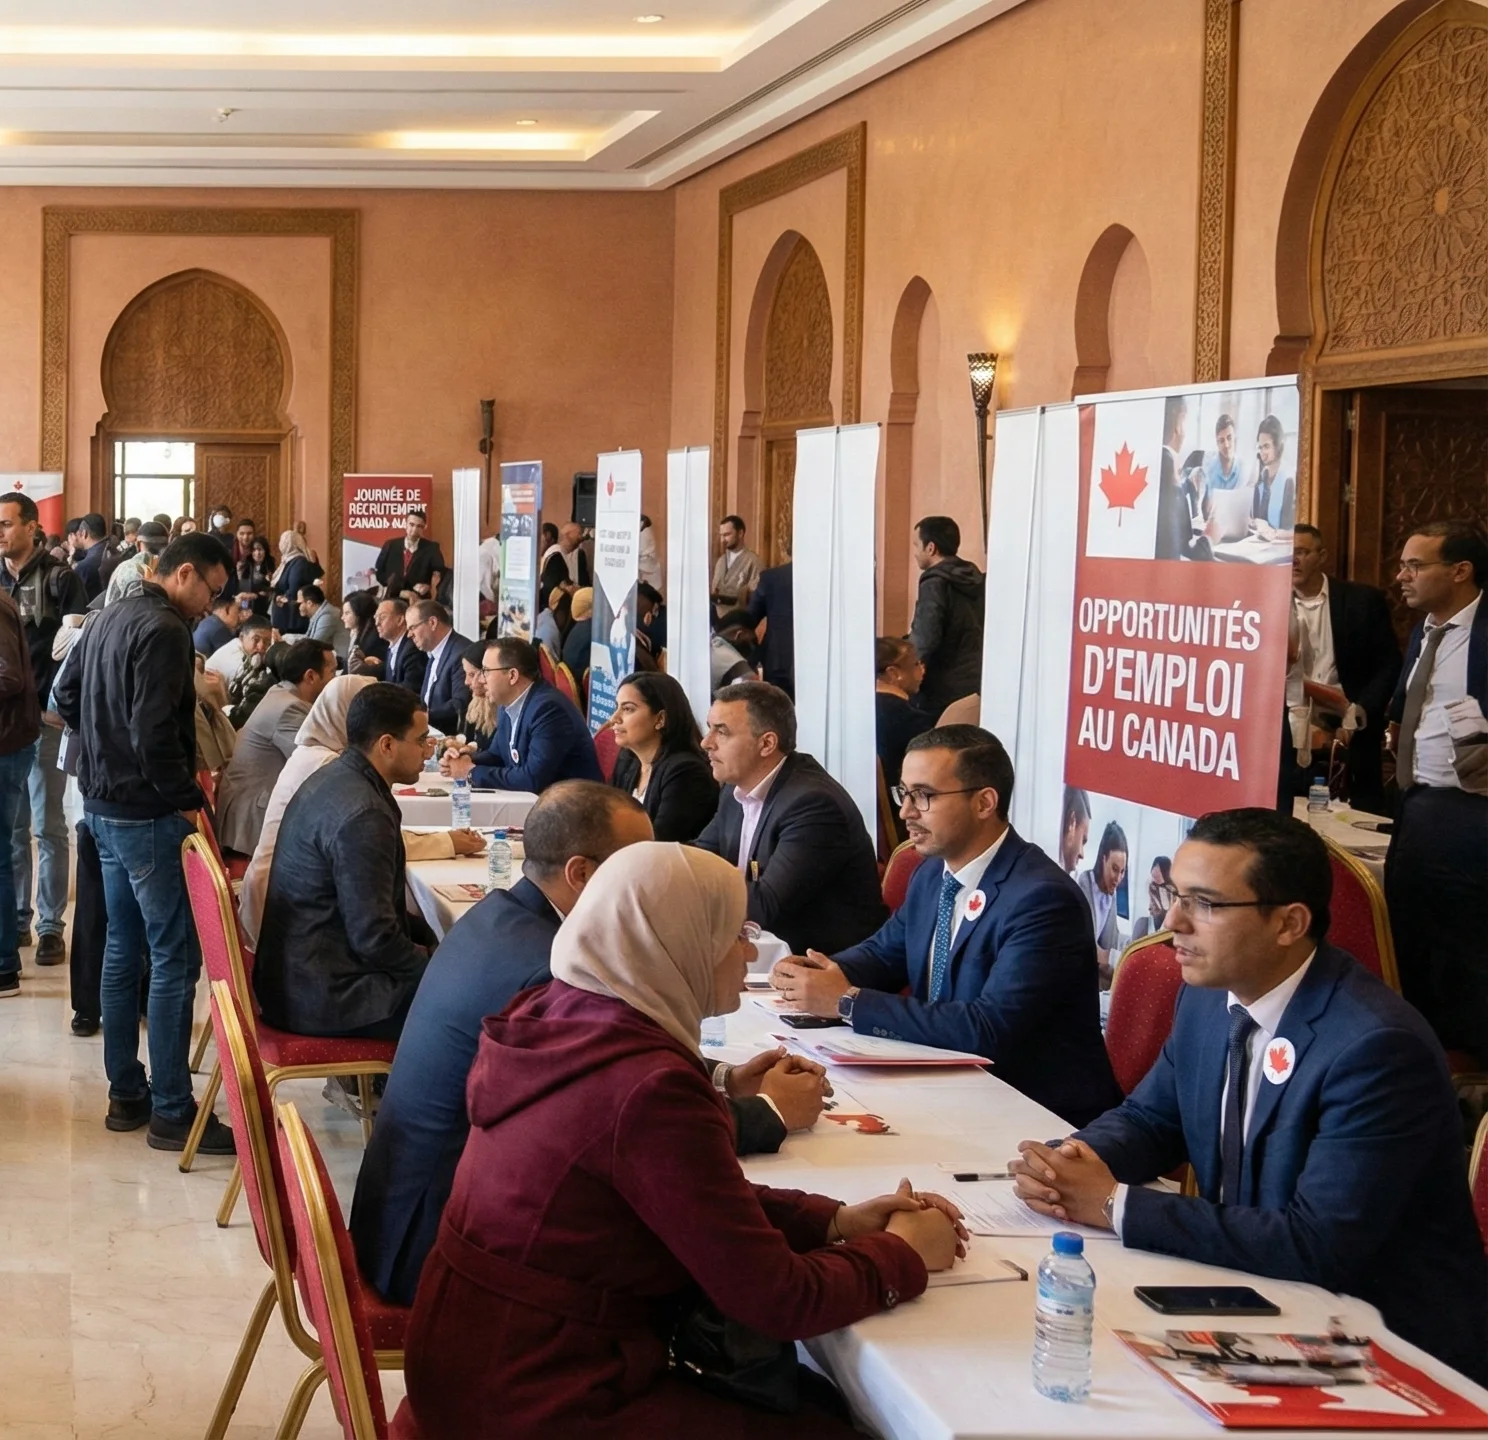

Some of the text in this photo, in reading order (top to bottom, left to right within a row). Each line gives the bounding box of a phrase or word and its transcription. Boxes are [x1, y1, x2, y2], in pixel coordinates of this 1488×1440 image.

[354, 486, 421, 501] JOURNÉE DE
[1079, 597, 1261, 651] OPPORTUNITÉS
[1082, 644, 1244, 720] D'EMPLOI
[1078, 706, 1240, 781] AU CANADA
